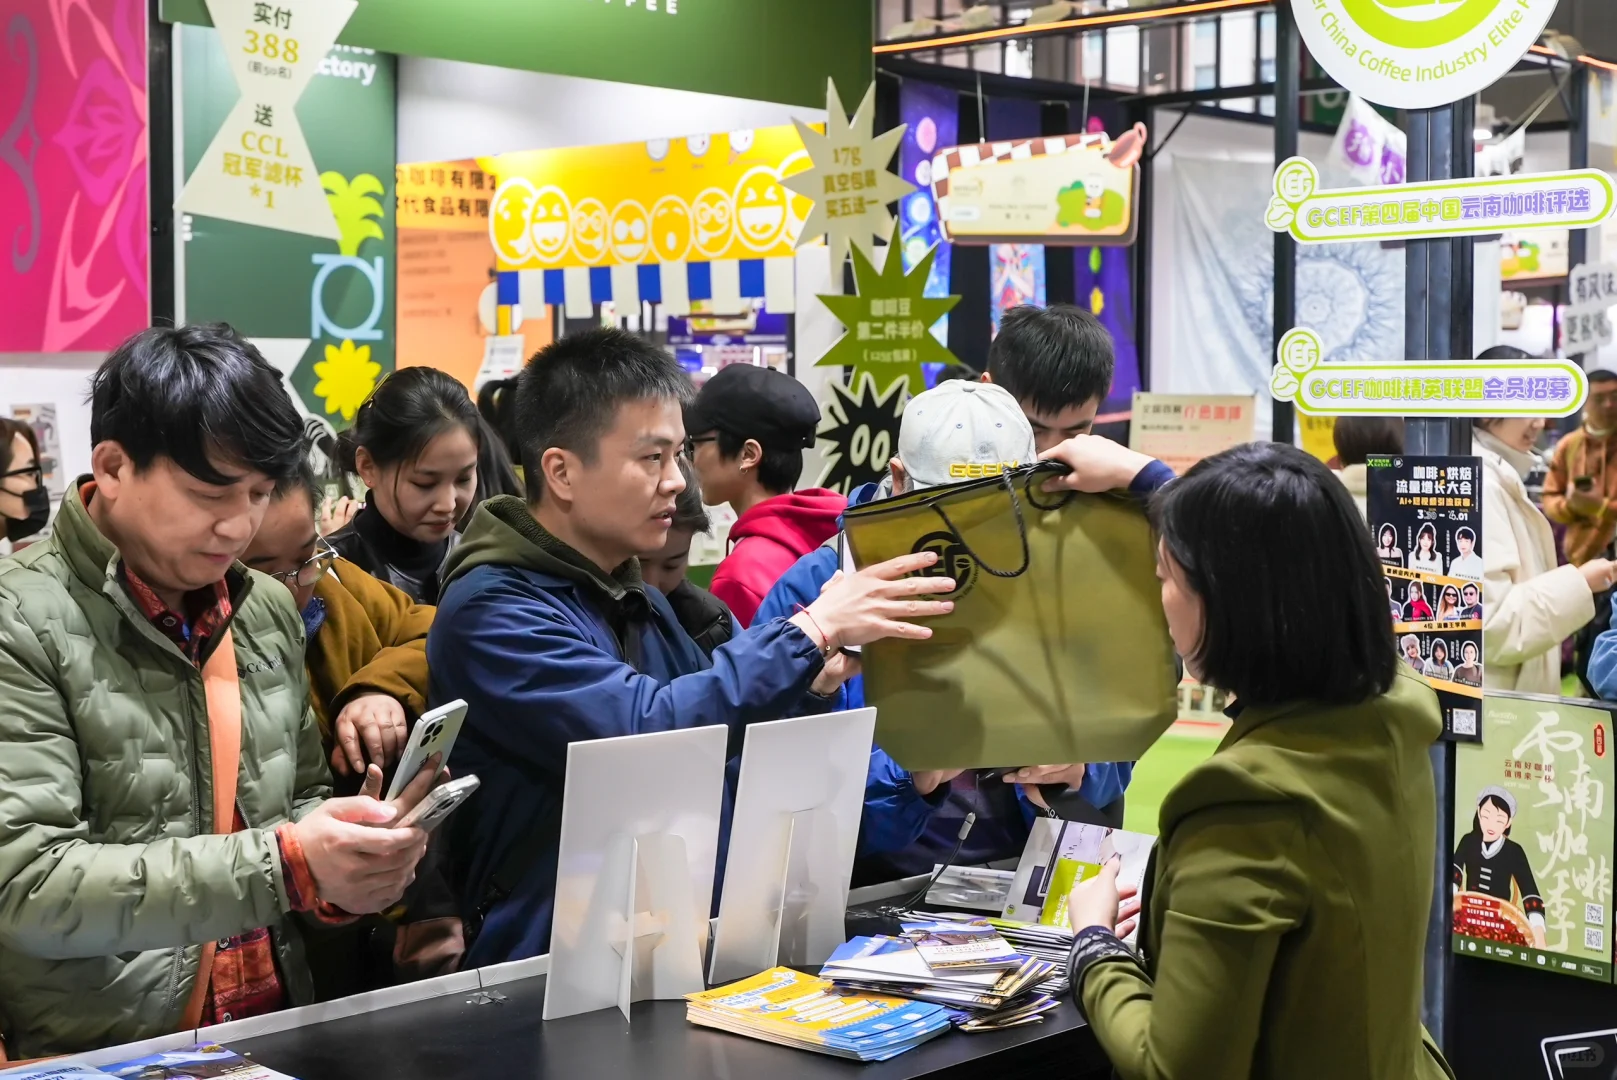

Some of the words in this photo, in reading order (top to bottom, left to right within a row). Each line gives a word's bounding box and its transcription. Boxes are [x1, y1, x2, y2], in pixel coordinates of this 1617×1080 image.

[253, 2, 293, 30] 实付
[242, 29, 300, 64] 388
[1320, 11, 1358, 57] China
[1358, 49, 1412, 82] Coffee
[1415, 41, 1489, 82] Industry
[1487, 8, 1524, 48] Elite
[314, 54, 377, 87] ctory
[253, 103, 274, 128] 送
[240, 130, 289, 159] CCL
[221, 152, 304, 189] 冠军滤杯
[1306, 187, 1592, 229] GCEF第四届中国云南咖啡评选
[1309, 376, 1572, 401] GCEF咖啡精英联盟会员招募
[1396, 479, 1472, 495] 流量增长大会
